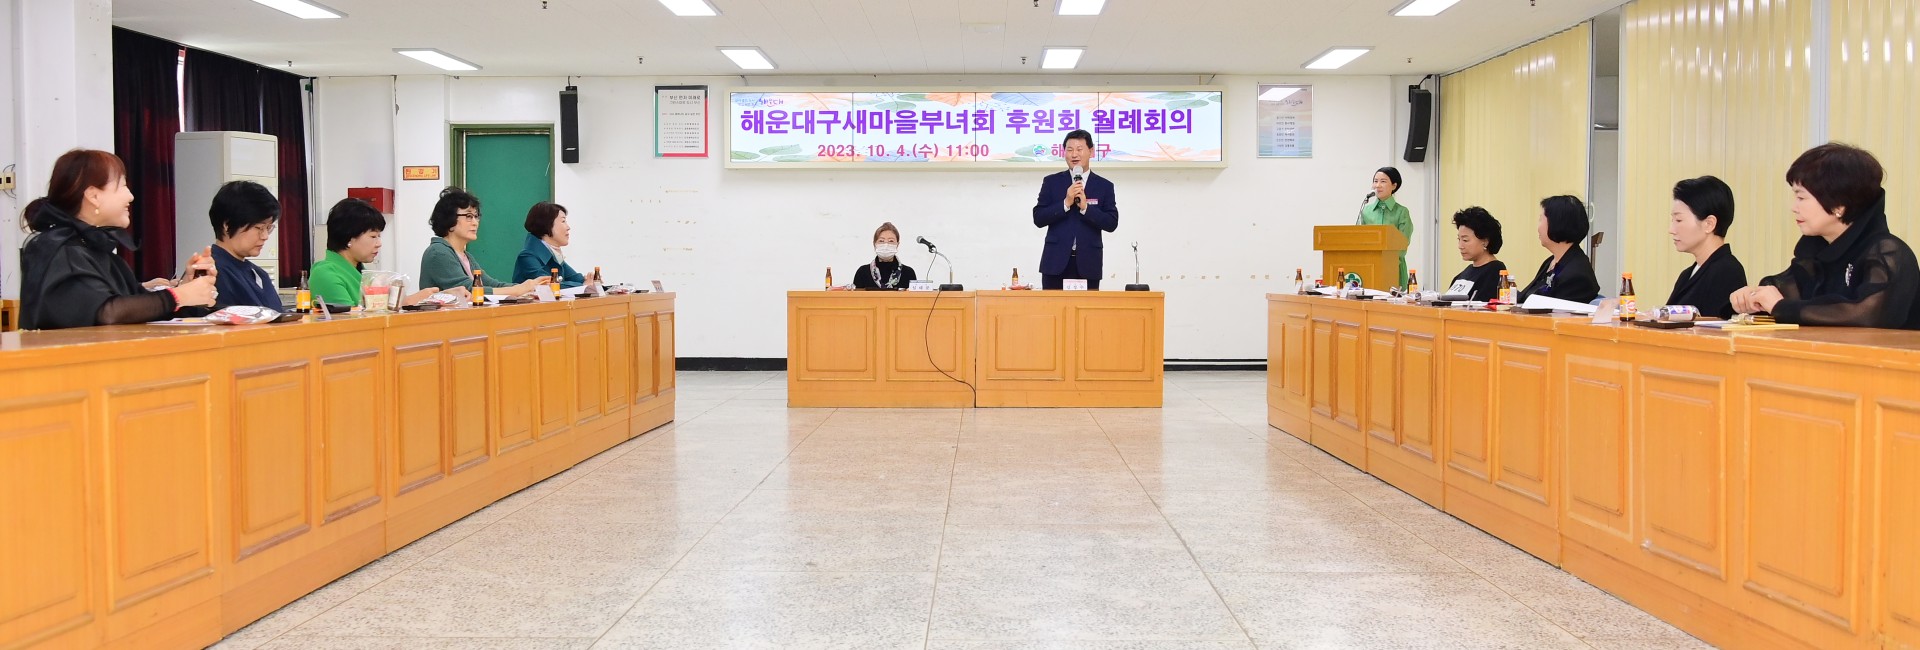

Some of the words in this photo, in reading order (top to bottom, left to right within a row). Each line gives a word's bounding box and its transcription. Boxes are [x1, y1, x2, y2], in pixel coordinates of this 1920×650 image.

[740, 109, 995, 134] 해운대구새마을부녀회
[1006, 109, 1080, 134] 후원회
[1091, 109, 1192, 134] 월례회의
[818, 144, 860, 157] 2023.
[867, 144, 890, 157] 10.
[896, 143, 939, 158] 4.(수)
[946, 144, 990, 157] 11:00
[1051, 144, 1111, 158] 해구
